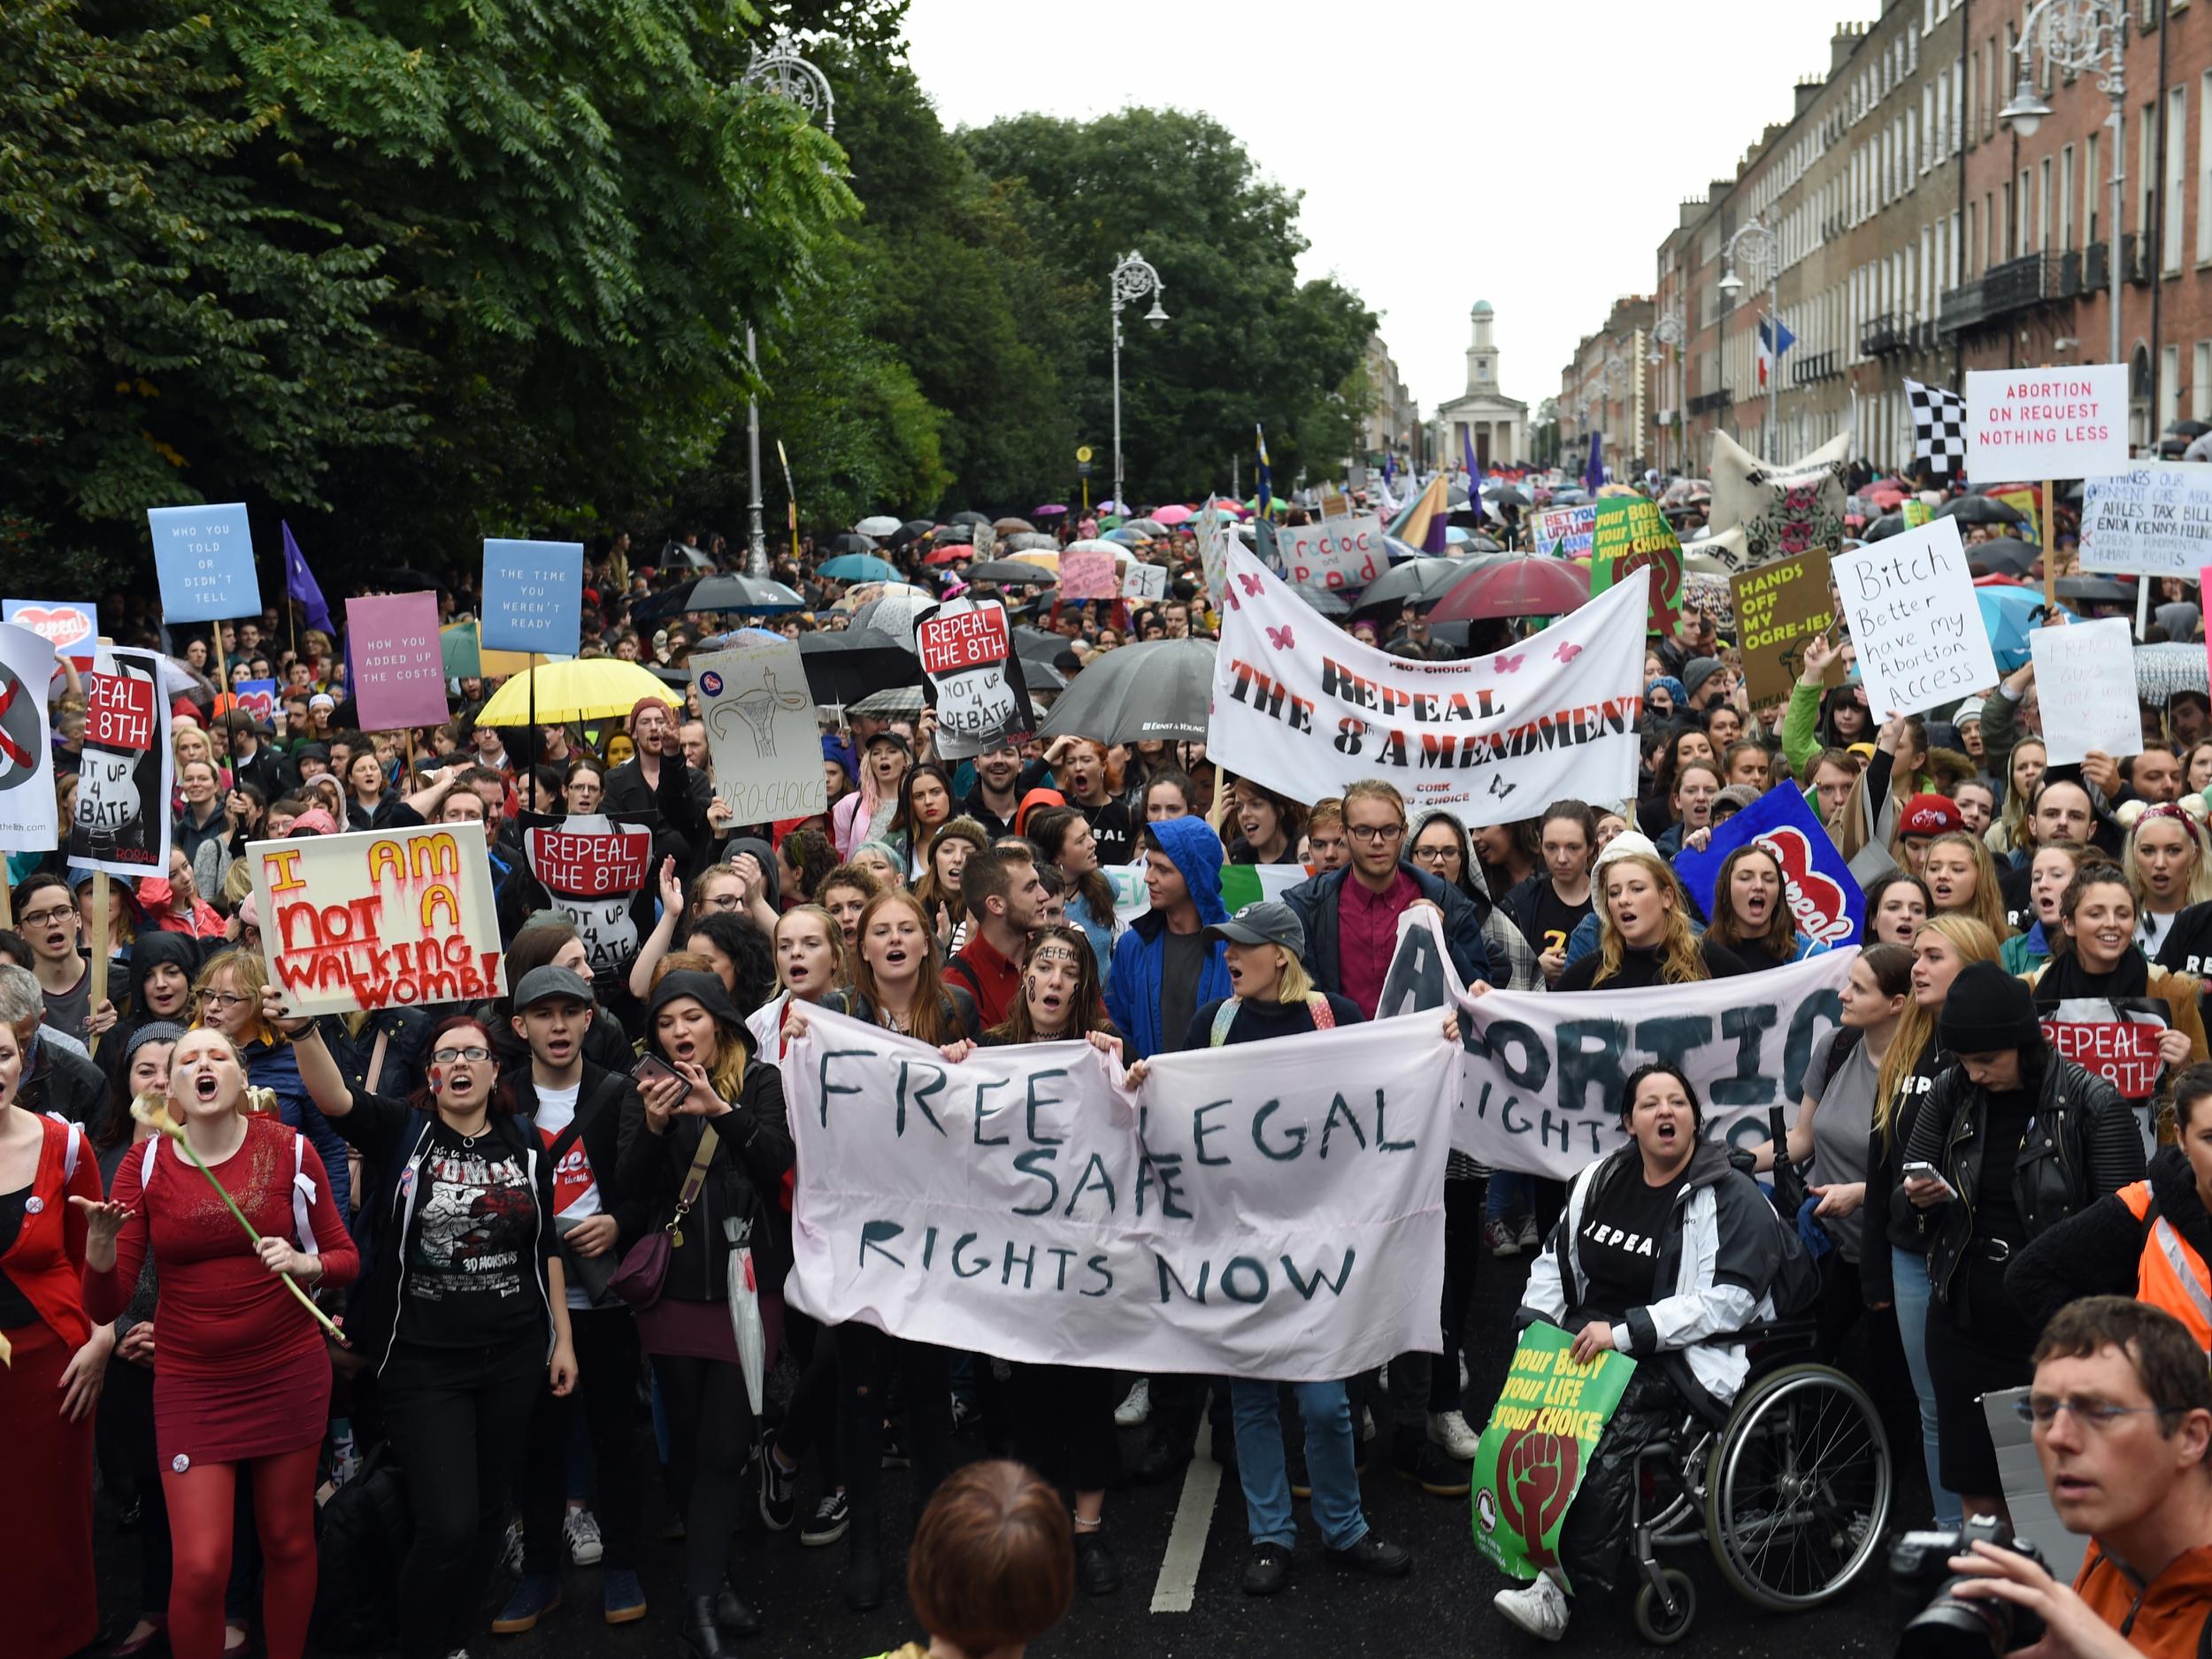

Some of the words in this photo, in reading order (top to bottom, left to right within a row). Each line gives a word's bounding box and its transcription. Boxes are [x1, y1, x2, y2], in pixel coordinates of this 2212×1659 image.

[2007, 382, 2092, 399] ABORTION
[1990, 407, 2012, 422] ON
[2021, 403, 2099, 421] REQUEST
[1980, 429, 2056, 446] NOTHING
[2066, 426, 2108, 442] LESS
[1545, 511, 1571, 527] BET
[1595, 510, 1626, 529] your
[1627, 502, 1660, 521] BOD
[2152, 503, 2176, 519] TAX
[172, 526, 197, 537] WHO
[205, 524, 230, 535] YOU
[1597, 526, 1628, 545] your
[1630, 519, 1661, 539] LIFE
[2097, 517, 2130, 533] ENDA
[188, 541, 220, 553] TOLD
[1598, 541, 1631, 563] your
[198, 559, 214, 570] OR
[1321, 557, 1340, 566] and
[1854, 544, 1952, 602] Bitch
[184, 572, 233, 588] DIDN'T
[500, 568, 524, 580] THE
[534, 570, 566, 581] TIME
[1739, 562, 1803, 598] HANDS
[195, 592, 227, 603] TELL
[520, 586, 544, 596] YOU
[503, 601, 560, 613] WEREN'T
[1741, 591, 1778, 615] OFF
[511, 618, 551, 629] READY
[927, 611, 998, 645] REPEAL
[1743, 611, 1773, 634] MY
[1856, 595, 1938, 638] Better
[1745, 611, 1832, 651] OGRE-IES
[367, 639, 392, 650] HOW
[401, 636, 426, 648] YOU
[926, 641, 962, 669] THE
[966, 634, 1005, 661] 8TH
[1864, 632, 1917, 664] have
[365, 653, 407, 666] ADDED
[416, 651, 432, 663] UP
[1388, 660, 1414, 672] PRO
[1424, 664, 1472, 674] CHOICE
[1880, 642, 1968, 680] Abortion
[363, 672, 388, 683] THE
[396, 667, 437, 680] COSTS
[943, 679, 974, 700] NOT
[984, 672, 1000, 690] UP
[972, 693, 982, 708] 4
[1230, 657, 1316, 736] THE
[1321, 656, 1505, 724] REPEAL
[946, 698, 1011, 731] DEBATE
[99, 710, 148, 745] 8TH
[1179, 722, 1206, 733] YOUNG
[107, 763, 127, 783] UP
[90, 780, 101, 801] 4
[1417, 783, 1450, 793] CORK
[1425, 792, 1471, 806] CHOICE
[542, 833, 639, 864] REPEAL
[263, 849, 307, 893] I
[367, 832, 459, 883] AM
[537, 857, 584, 890] THE
[594, 863, 641, 891] 8TH
[419, 883, 459, 928] A
[605, 904, 624, 926] UP
[583, 927, 598, 944] 4
[274, 934, 472, 992] WALKING
[1036, 946, 1078, 962] REPEAL
[354, 952, 500, 1010] WOMB!
[2101, 1062, 2155, 1093] 8TH
[819, 1048, 1070, 1148] FREE
[1140, 1088, 1417, 1166] LEGAL
[1011, 1148, 1194, 1219] SAFE
[462, 1256, 479, 1274] 3D
[479, 1250, 518, 1271] MONSTERS
[858, 1220, 1115, 1297] RIGHTS
[1157, 1248, 1356, 1304] NOW
[1510, 1348, 1555, 1374] your
[1500, 1375, 1545, 1402] your
[1543, 1375, 1586, 1408] LIFE
[1492, 1403, 1538, 1432] your
[1536, 1405, 1603, 1442] CHOICE
